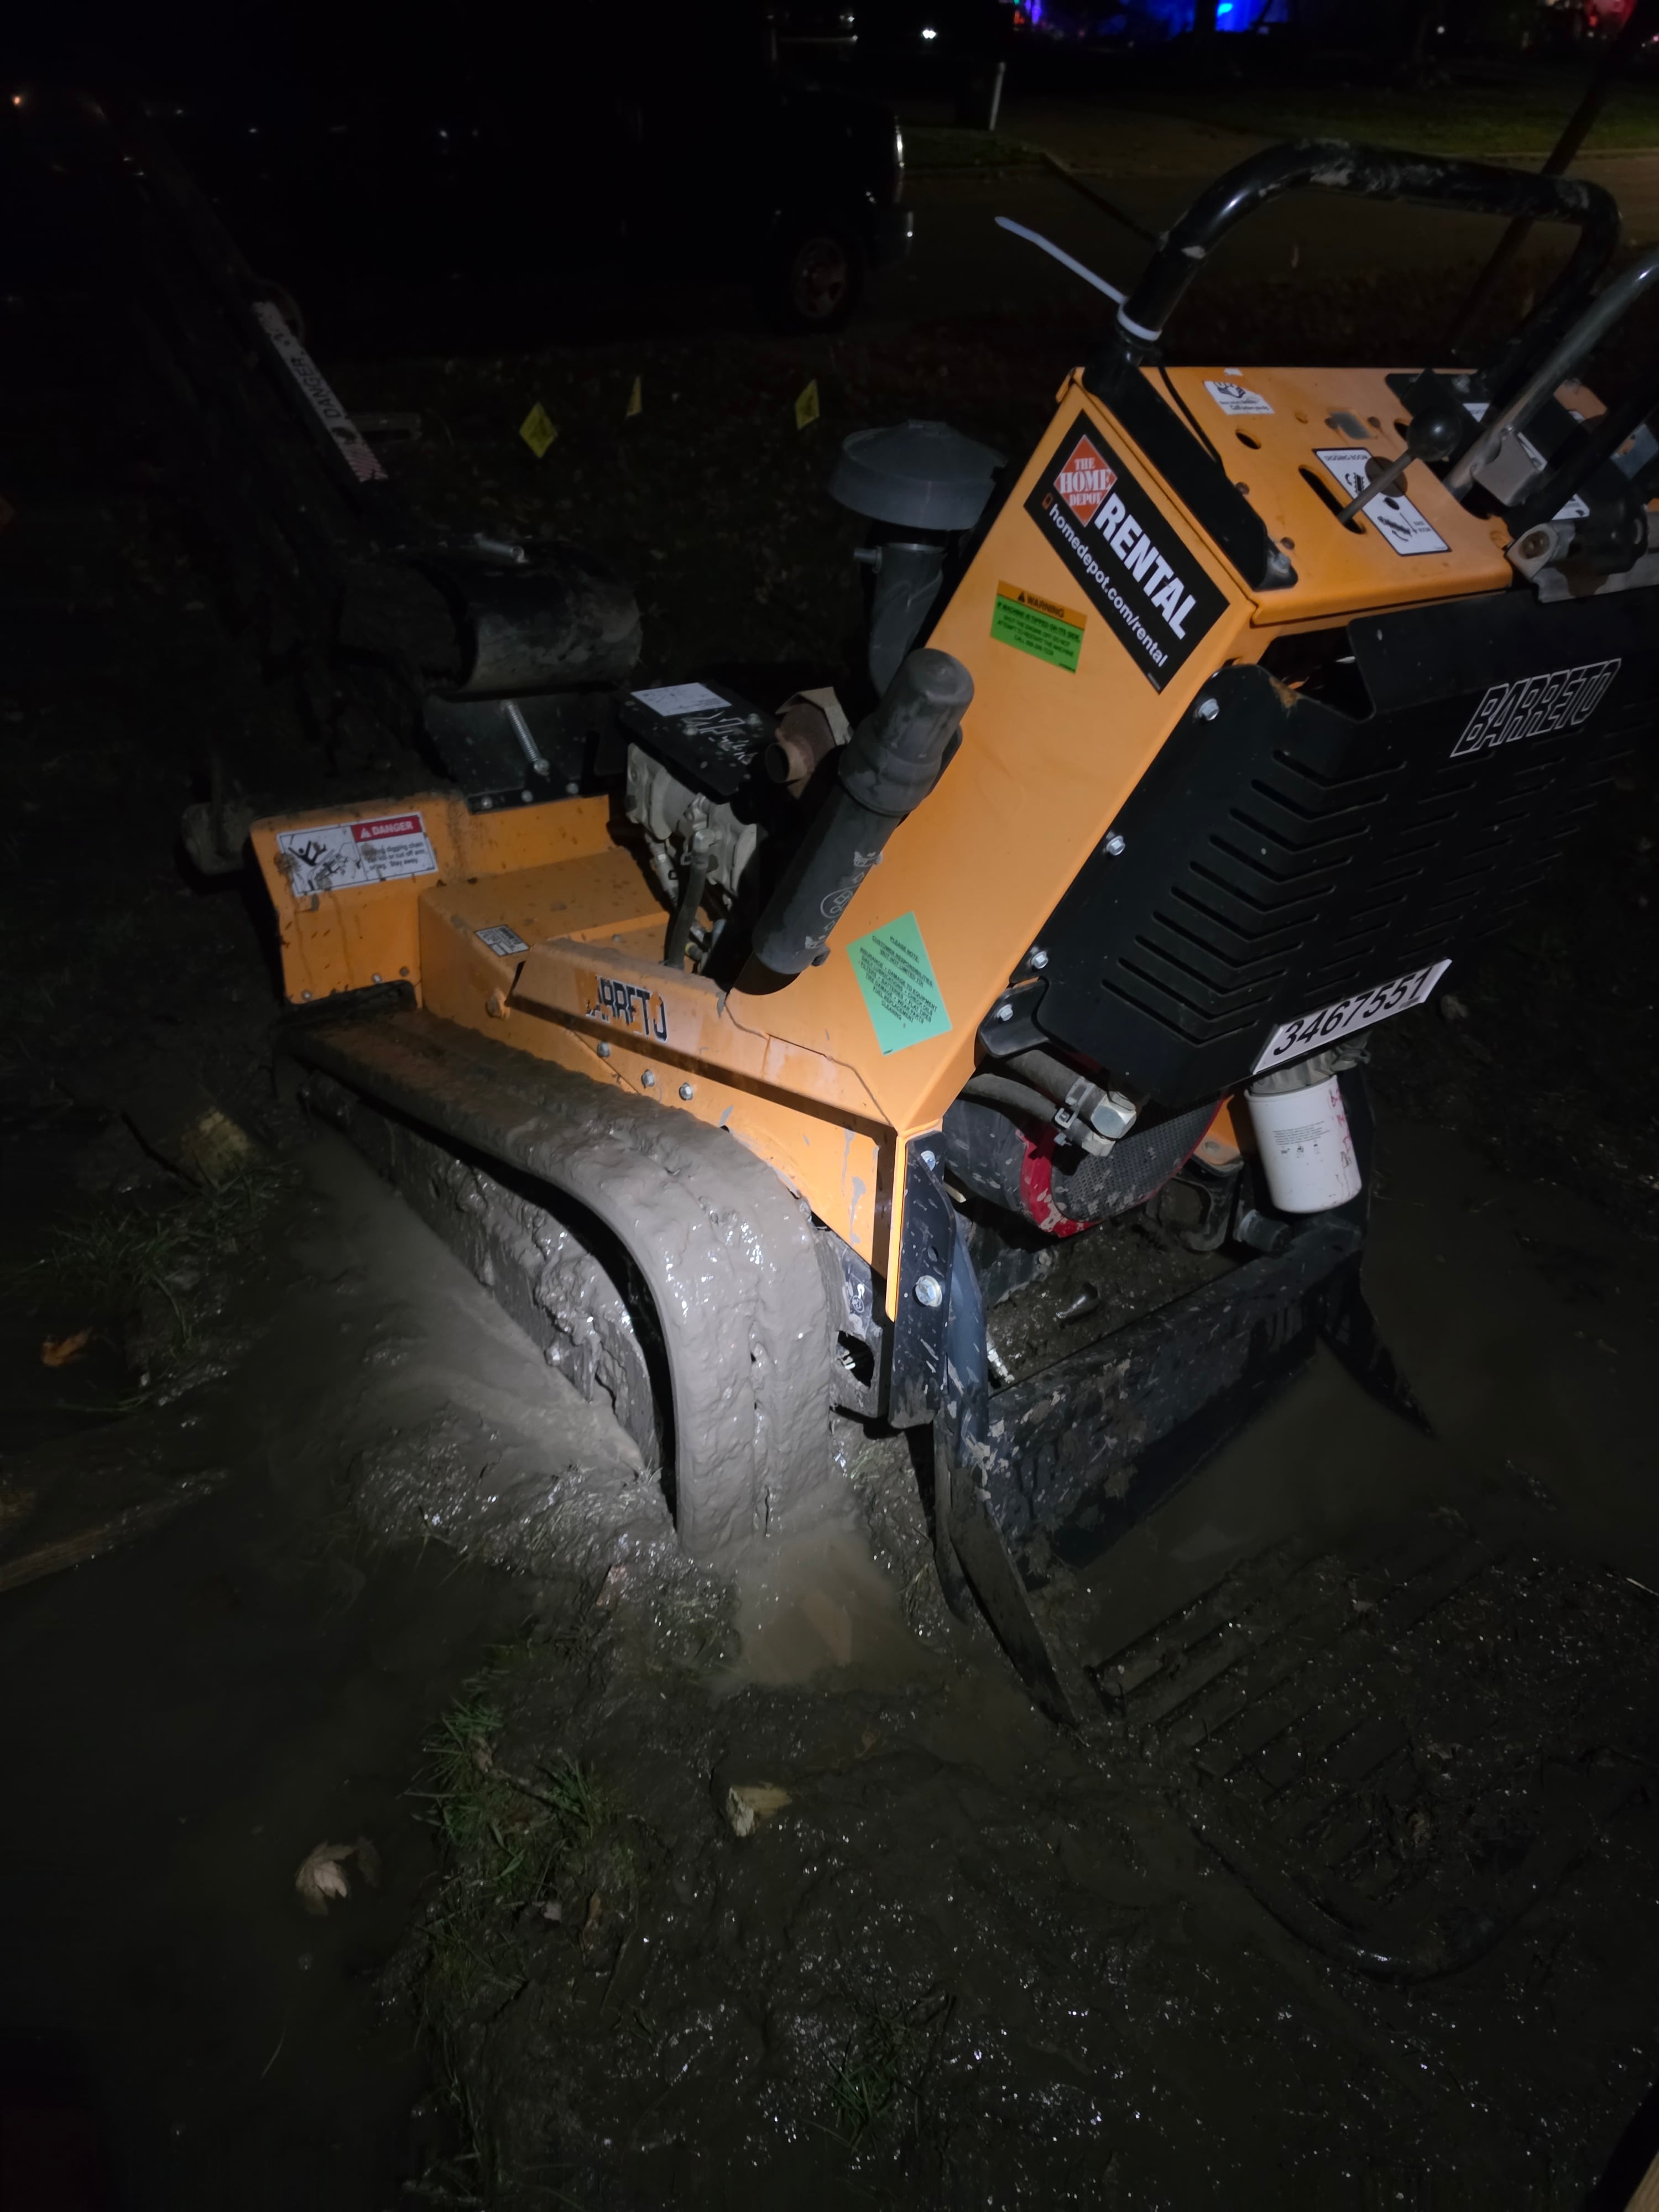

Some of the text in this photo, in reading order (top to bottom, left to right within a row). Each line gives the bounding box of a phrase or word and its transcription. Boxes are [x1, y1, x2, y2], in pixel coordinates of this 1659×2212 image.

[291, 358, 341, 419] DANGER
[1074, 457, 1095, 471] THE
[1059, 468, 1112, 493] HOME
[1068, 492, 1103, 506] DEPOT
[1094, 492, 1196, 640] RENTAL
[1048, 504, 1168, 667] homedepot.com/rental
[1026, 594, 1065, 619] WARNING
[1449, 658, 1622, 758] BARRETO
[371, 820, 414, 836] DANGER
[890, 936, 906, 952] PLEASE
[913, 989, 937, 1012] EQUIPMENT
[1273, 967, 1433, 1056] 3467551
